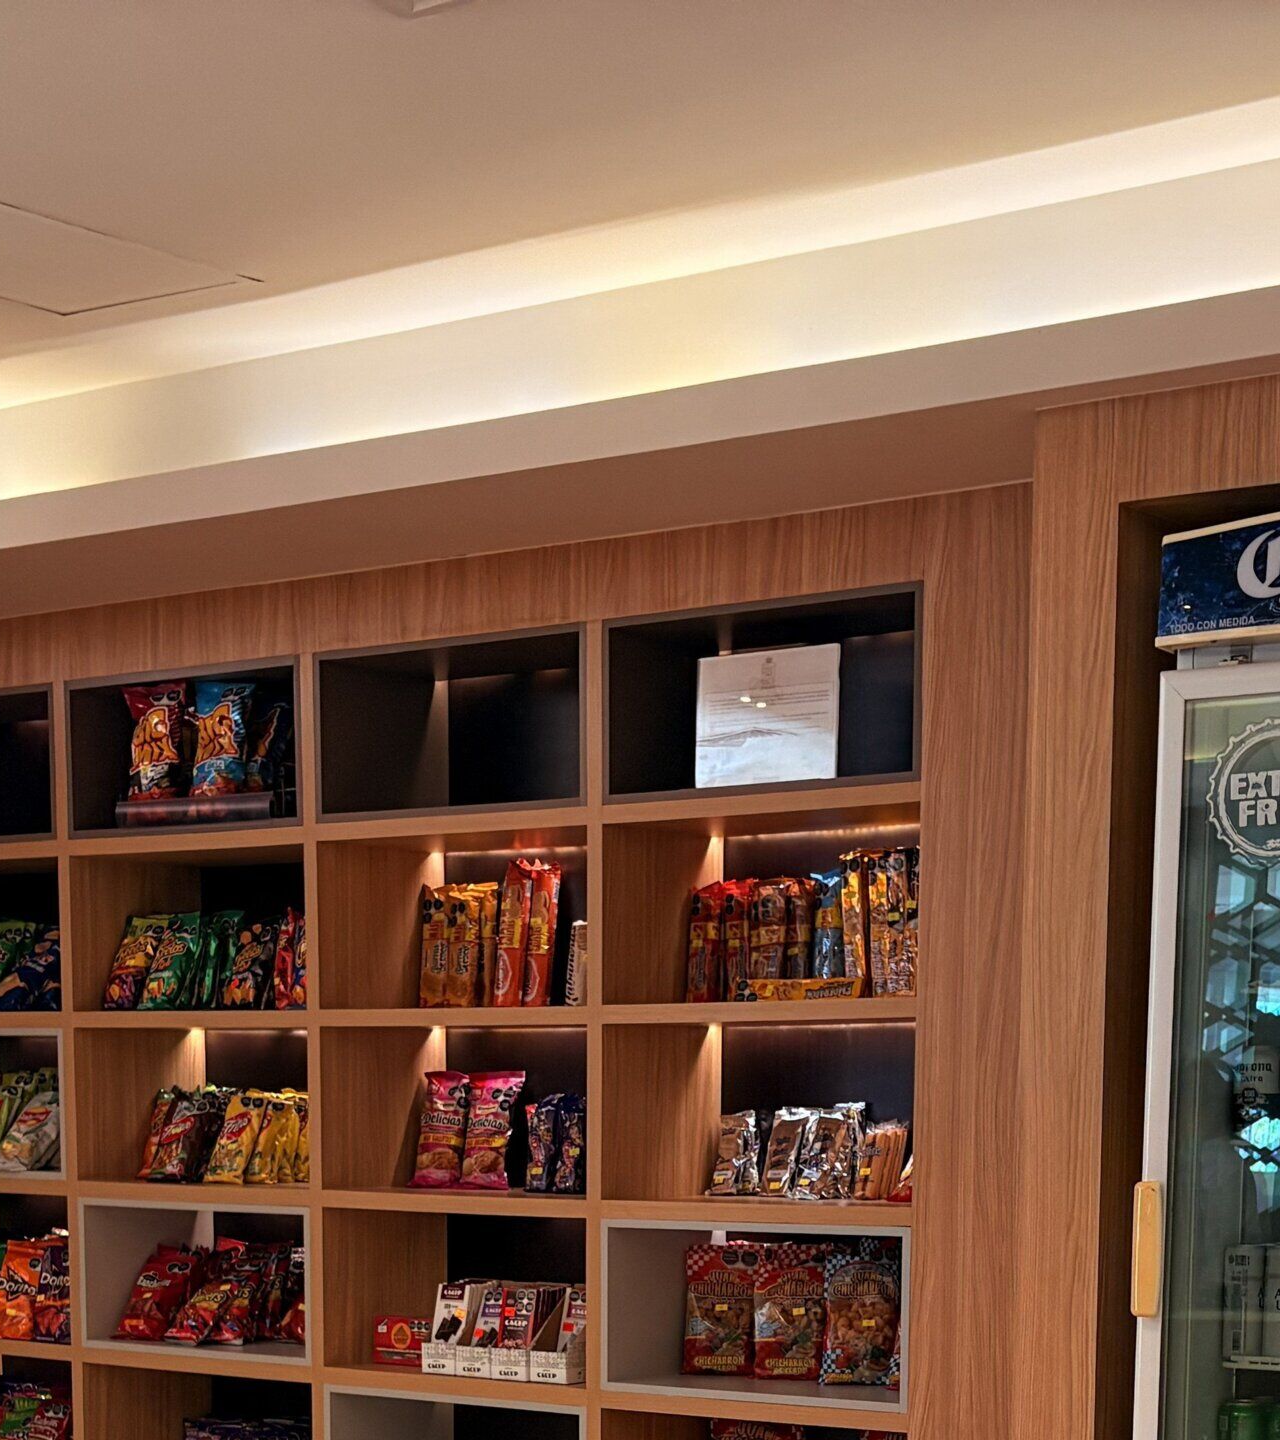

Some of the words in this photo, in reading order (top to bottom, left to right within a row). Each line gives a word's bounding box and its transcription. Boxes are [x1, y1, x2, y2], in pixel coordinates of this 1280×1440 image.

[1169, 623, 1195, 633] TODO
[1196, 619, 1217, 631] CON
[1218, 615, 1256, 628] MEDIDA
[423, 1112, 462, 1127] Delicias
